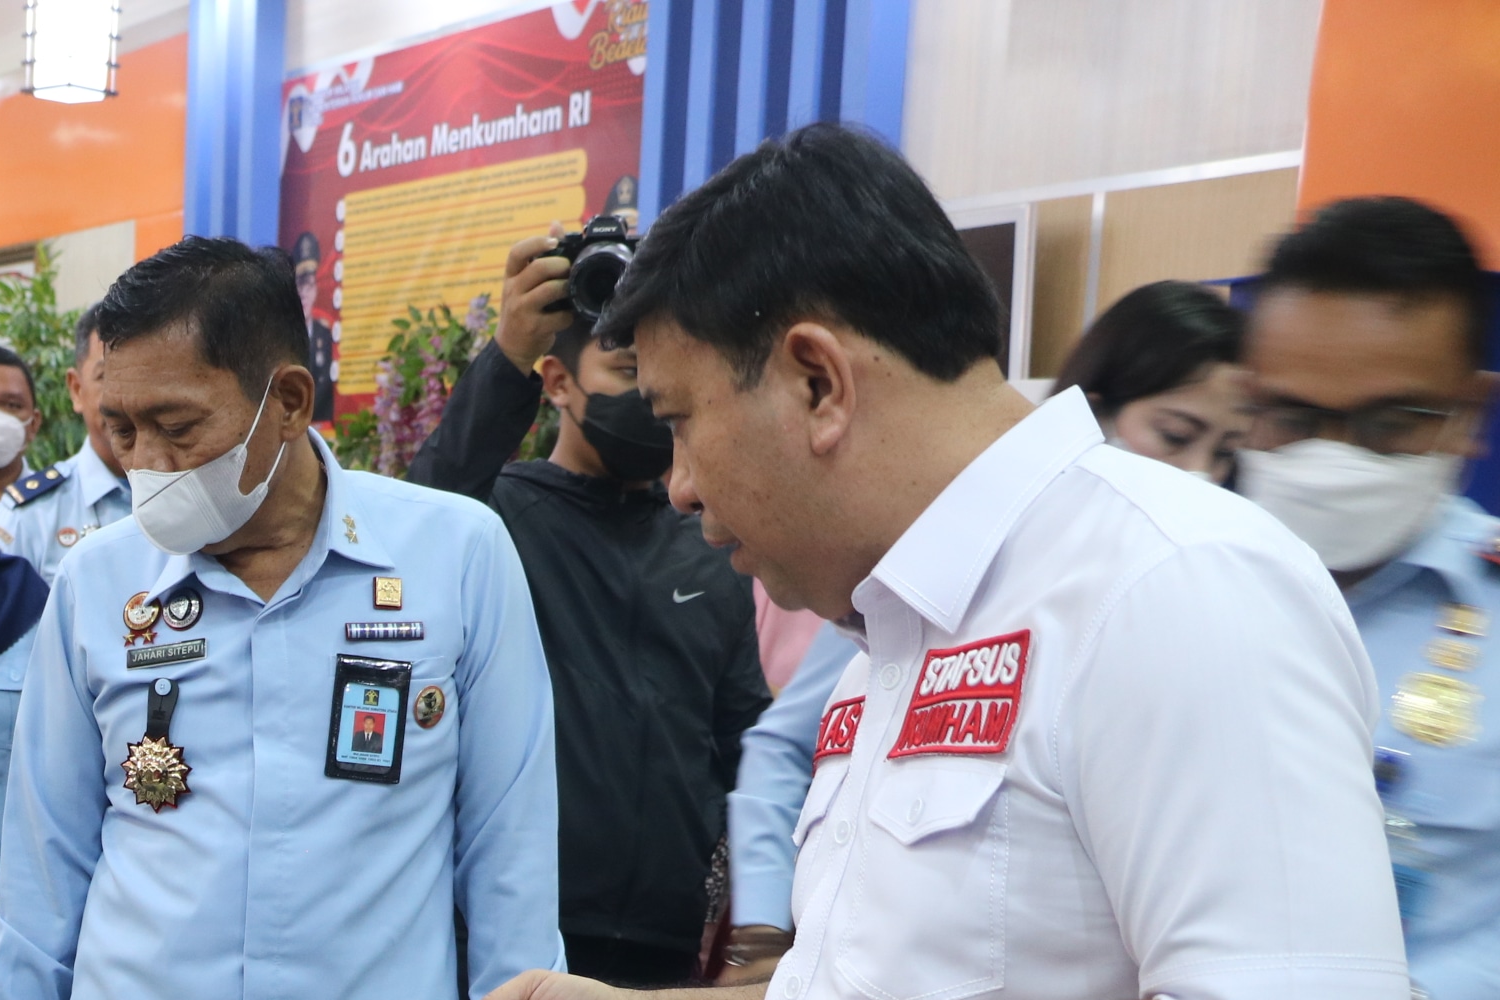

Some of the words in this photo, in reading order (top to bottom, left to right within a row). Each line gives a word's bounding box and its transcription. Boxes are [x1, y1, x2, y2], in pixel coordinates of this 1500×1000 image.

[336, 121, 357, 178] 6
[359, 132, 427, 173] Arahan
[430, 104, 563, 158] Menkumham
[568, 90, 592, 128] RI
[132, 650, 165, 662] JAHARI
[167, 645, 200, 657] SITEPU
[919, 642, 1021, 696] STAFSUS
